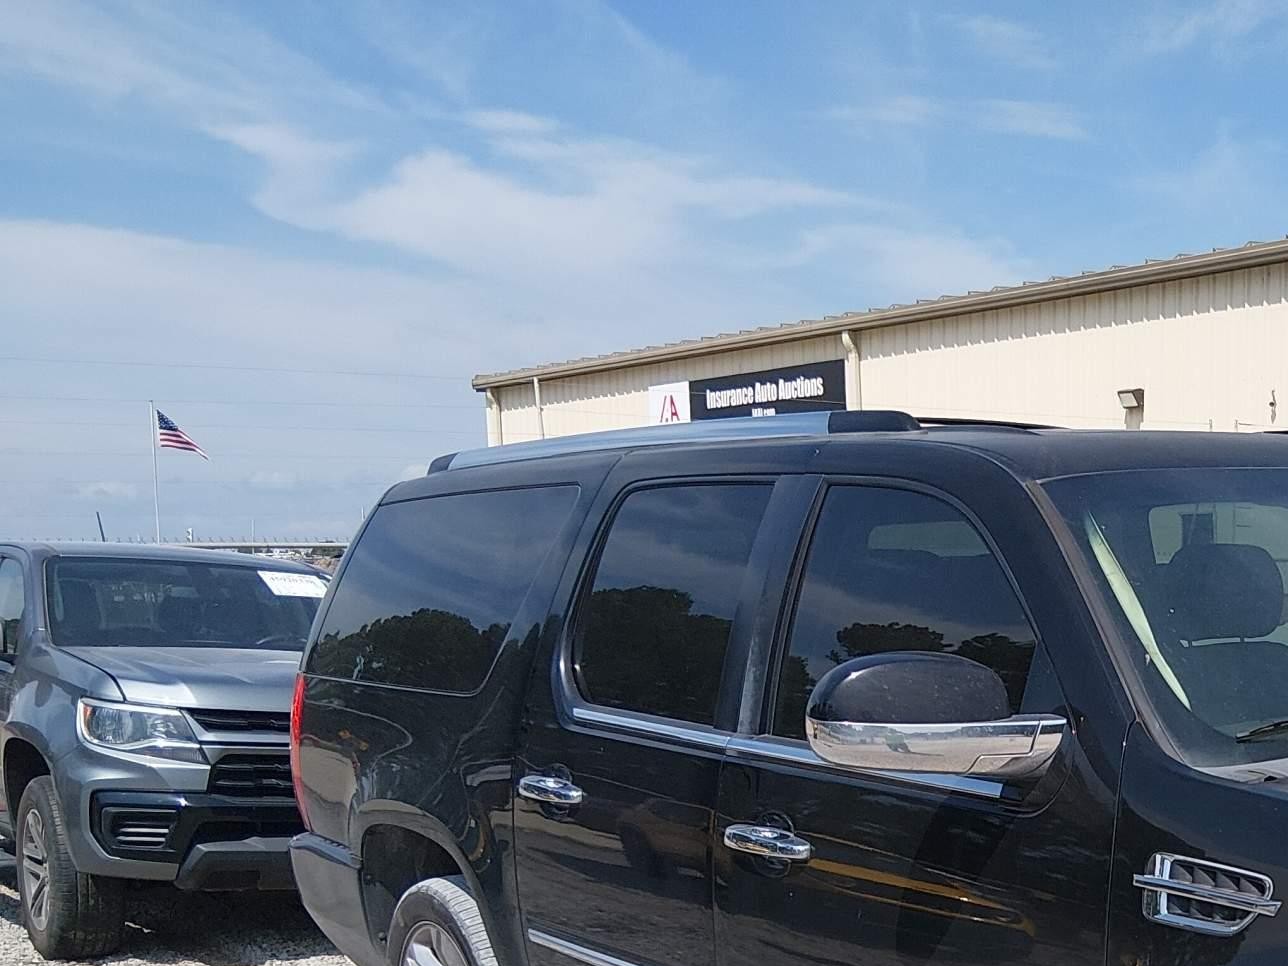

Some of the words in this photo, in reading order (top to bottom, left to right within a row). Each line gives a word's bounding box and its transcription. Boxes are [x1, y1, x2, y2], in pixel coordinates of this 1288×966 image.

[706, 388, 754, 410] Insurance
[754, 382, 777, 403] Auto
[778, 376, 824, 400] Auctions
